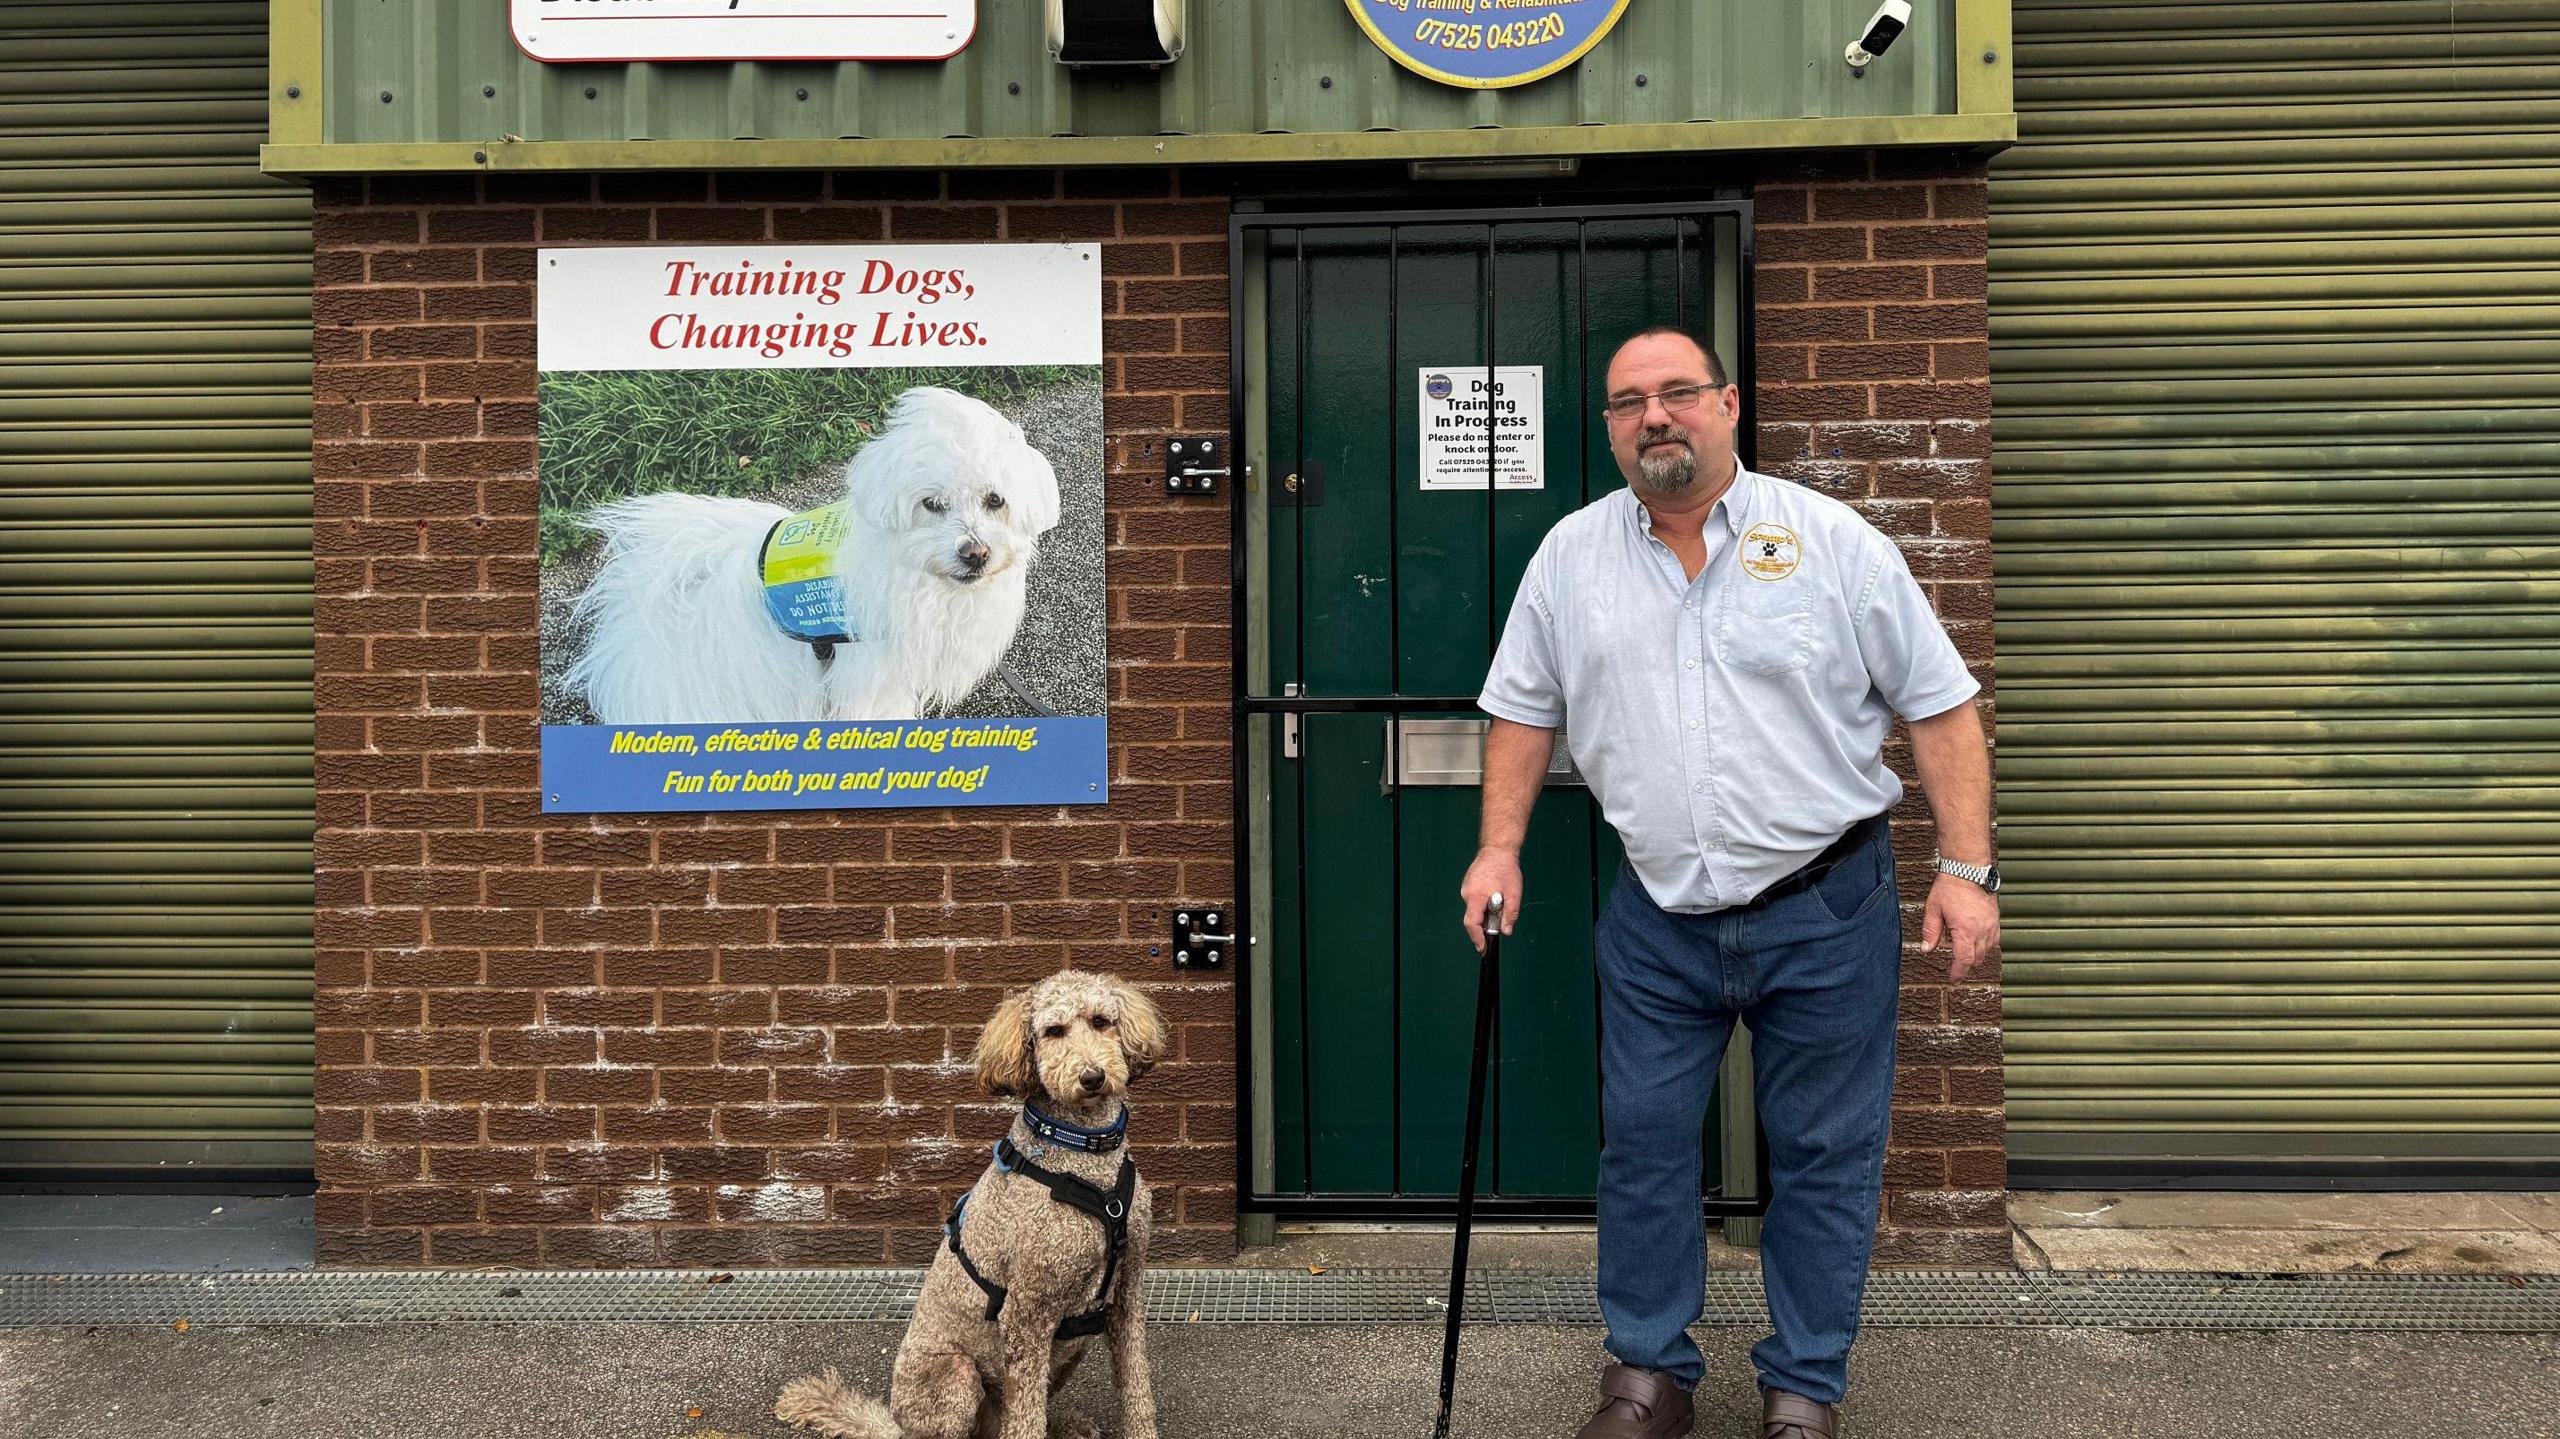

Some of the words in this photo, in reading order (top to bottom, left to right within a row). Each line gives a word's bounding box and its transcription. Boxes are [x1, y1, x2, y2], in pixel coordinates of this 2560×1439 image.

[1415, 18, 1482, 49] 07525
[1486, 12, 1565, 49] 043220
[664, 259, 846, 306] Training
[856, 259, 975, 305] Dogs,
[649, 311, 857, 359] Changing
[868, 311, 988, 348] Lives.
[1471, 380, 1504, 396] Dog
[1446, 397, 1516, 414] Trainng
[1435, 415, 1451, 427] In
[1455, 415, 1528, 431] Progress
[1428, 433, 1461, 442] Please
[1462, 432, 1475, 442] do
[1477, 433, 1490, 442] no
[1496, 432, 1522, 441] enter
[1524, 433, 1536, 441] or
[1444, 445, 1476, 454] knock
[1493, 445, 1519, 453] door.
[1436, 467, 1461, 475] require
[1462, 466, 1491, 474] attentio
[1438, 458, 1453, 466] Call
[1475, 458, 1503, 466] 04320
[1511, 459, 1525, 467] you
[1509, 473, 1533, 481] Access
[789, 607, 804, 617] DO
[807, 602, 828, 616] NOT
[609, 731, 699, 756] Modern,
[704, 729, 799, 753] effective
[803, 728, 823, 751] &
[825, 727, 903, 751] ethical
[904, 727, 950, 753] dog
[950, 725, 1039, 752] training.
[662, 771, 705, 794] Fun
[707, 770, 742, 793] for
[742, 769, 793, 793] both
[793, 773, 836, 796] you
[839, 767, 885, 791] and
[882, 770, 936, 795] your
[936, 765, 990, 793] dog!
